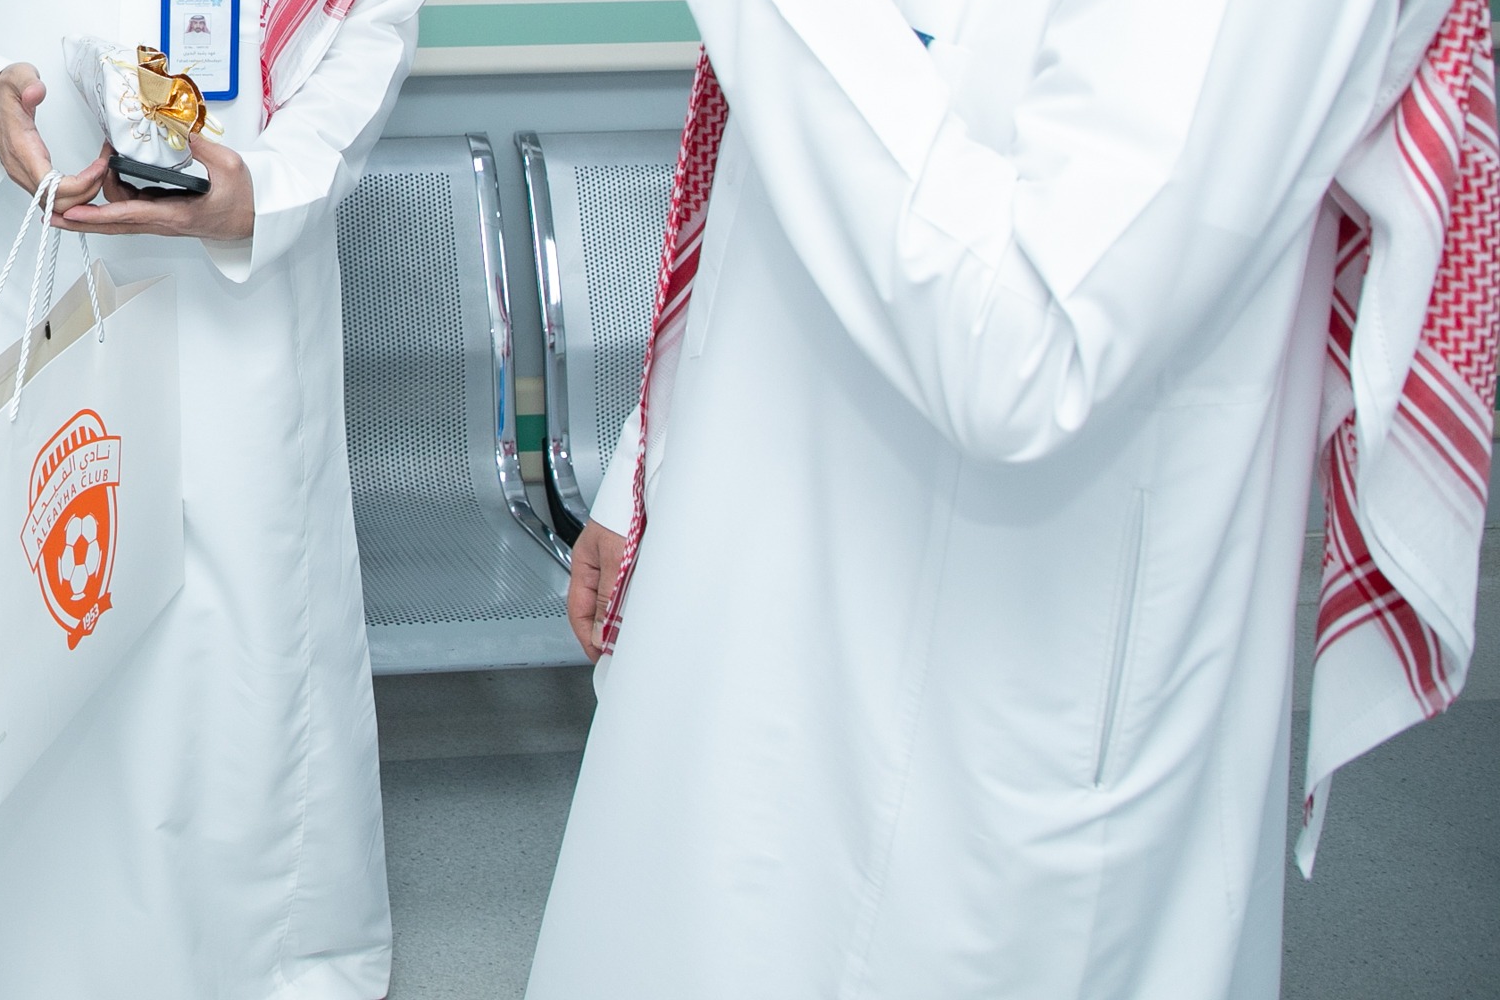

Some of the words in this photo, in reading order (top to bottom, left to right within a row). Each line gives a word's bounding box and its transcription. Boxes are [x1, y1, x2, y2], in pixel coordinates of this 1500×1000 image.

[79, 444, 110, 473] نادي
[36, 484, 77, 549] ALFAYHA
[80, 468, 109, 487] CLUB
[82, 603, 100, 630] 1953
